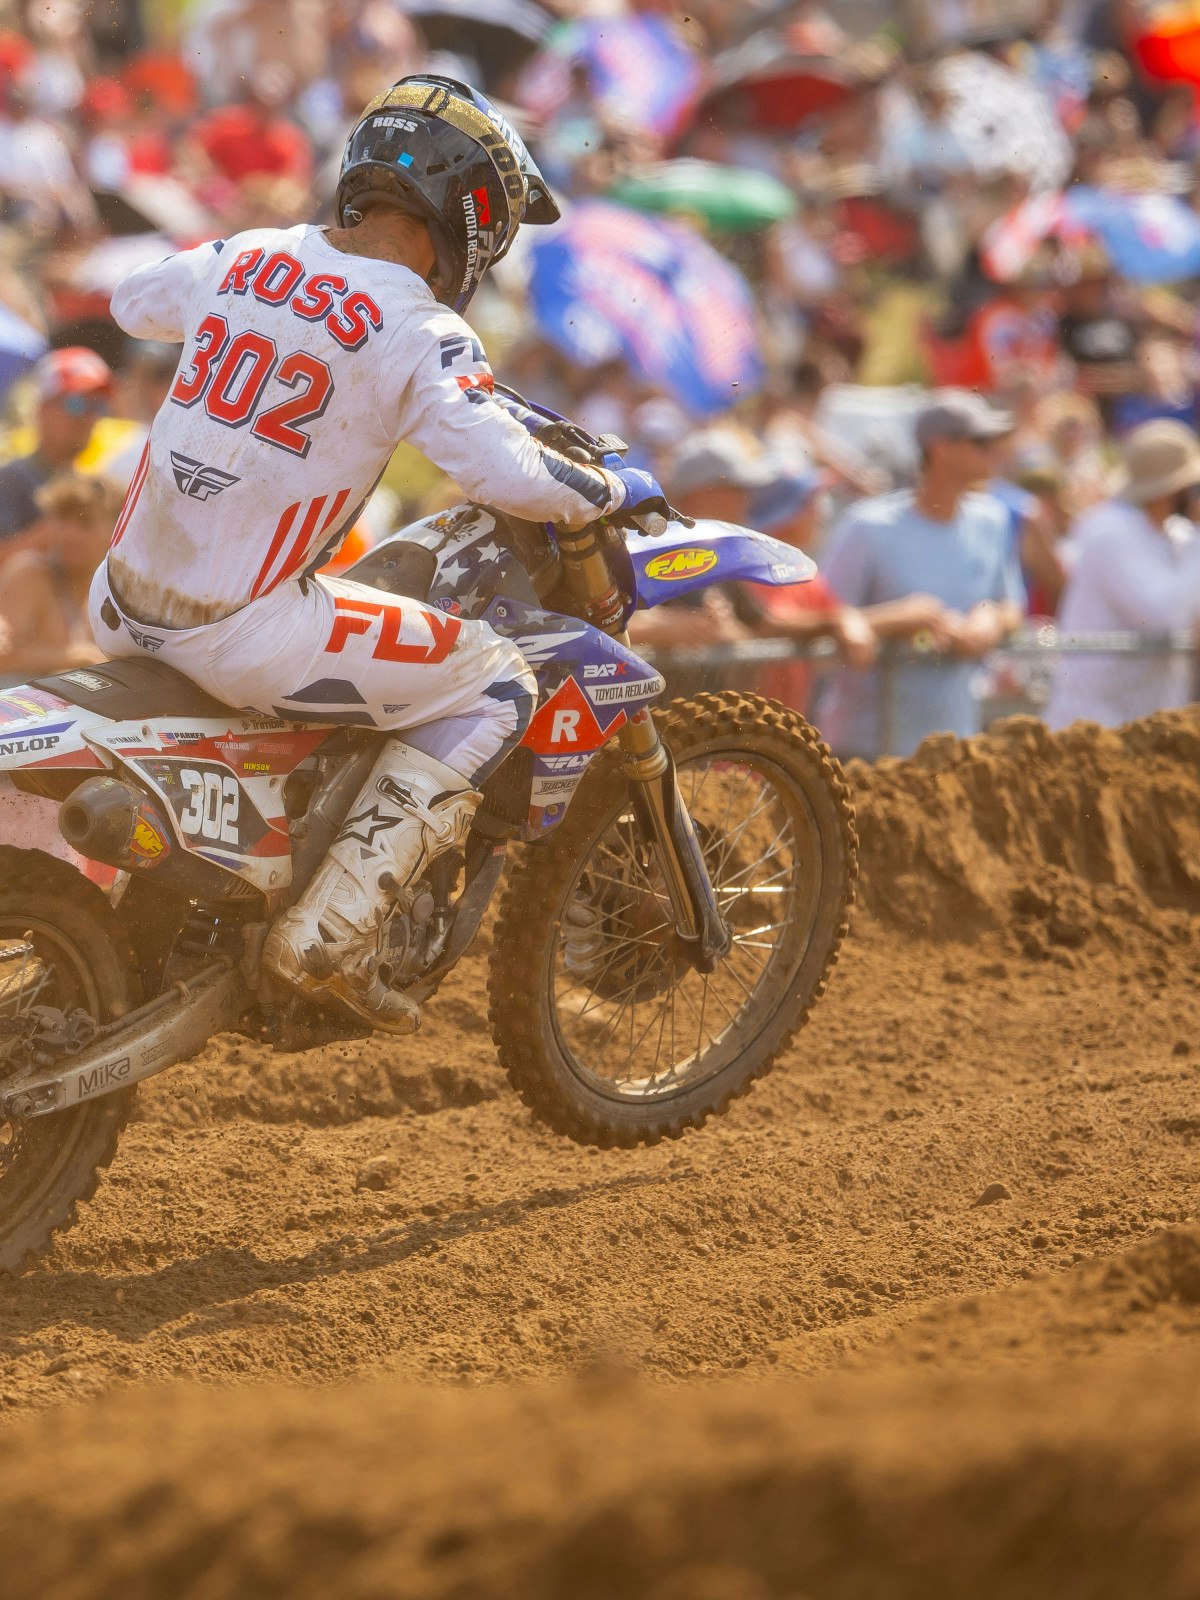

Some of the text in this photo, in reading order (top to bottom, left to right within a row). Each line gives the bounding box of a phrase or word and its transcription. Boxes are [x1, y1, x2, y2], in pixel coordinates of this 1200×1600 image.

[373, 117, 418, 132] ROSS
[461, 192, 477, 292] TOYOTA REDLANDS
[217, 247, 384, 352] ROSS
[439, 335, 488, 370] FL
[170, 312, 335, 459] 302
[647, 549, 715, 578] FMF
[324, 597, 462, 664] FLY
[583, 662, 628, 678] BARX
[595, 679, 661, 701] TOYOTA REDLANDS
[252, 718, 285, 731] Trimble
[550, 709, 581, 743] R
[115, 735, 142, 744] YAMAHA
[243, 762, 271, 771] HINSON
[540, 752, 596, 769] FLY
[179, 768, 240, 846] 302
